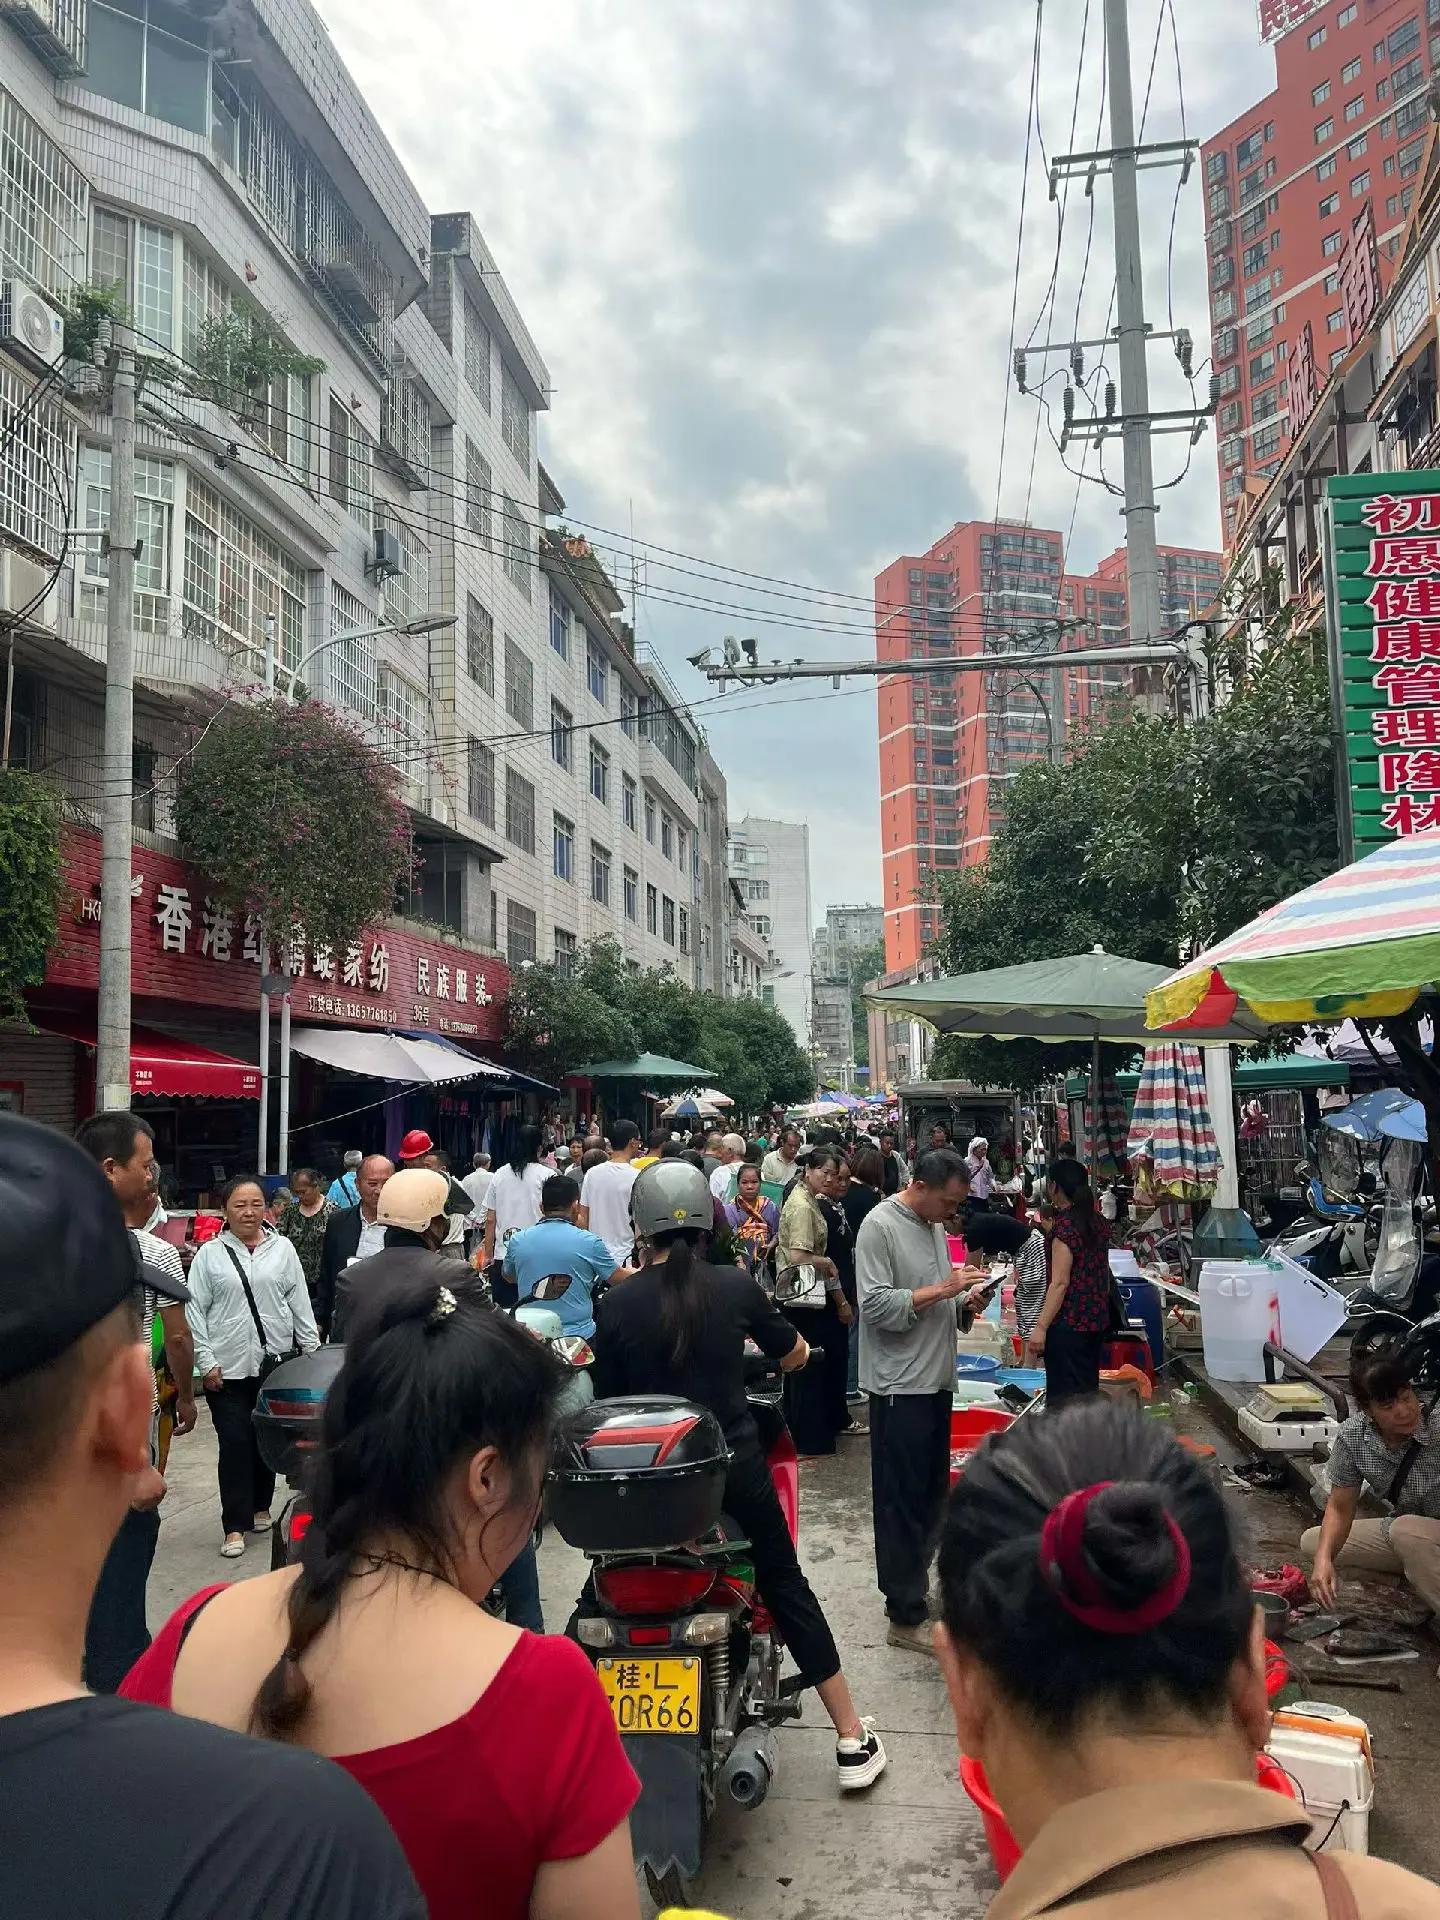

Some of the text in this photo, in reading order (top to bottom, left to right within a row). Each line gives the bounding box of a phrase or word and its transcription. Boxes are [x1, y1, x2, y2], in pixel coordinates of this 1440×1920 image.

[1361, 493, 1440, 835] 初愿健康管理隆林
[417, 956, 486, 1007] 民族服装
[413, 1004, 429, 1026] 36号
